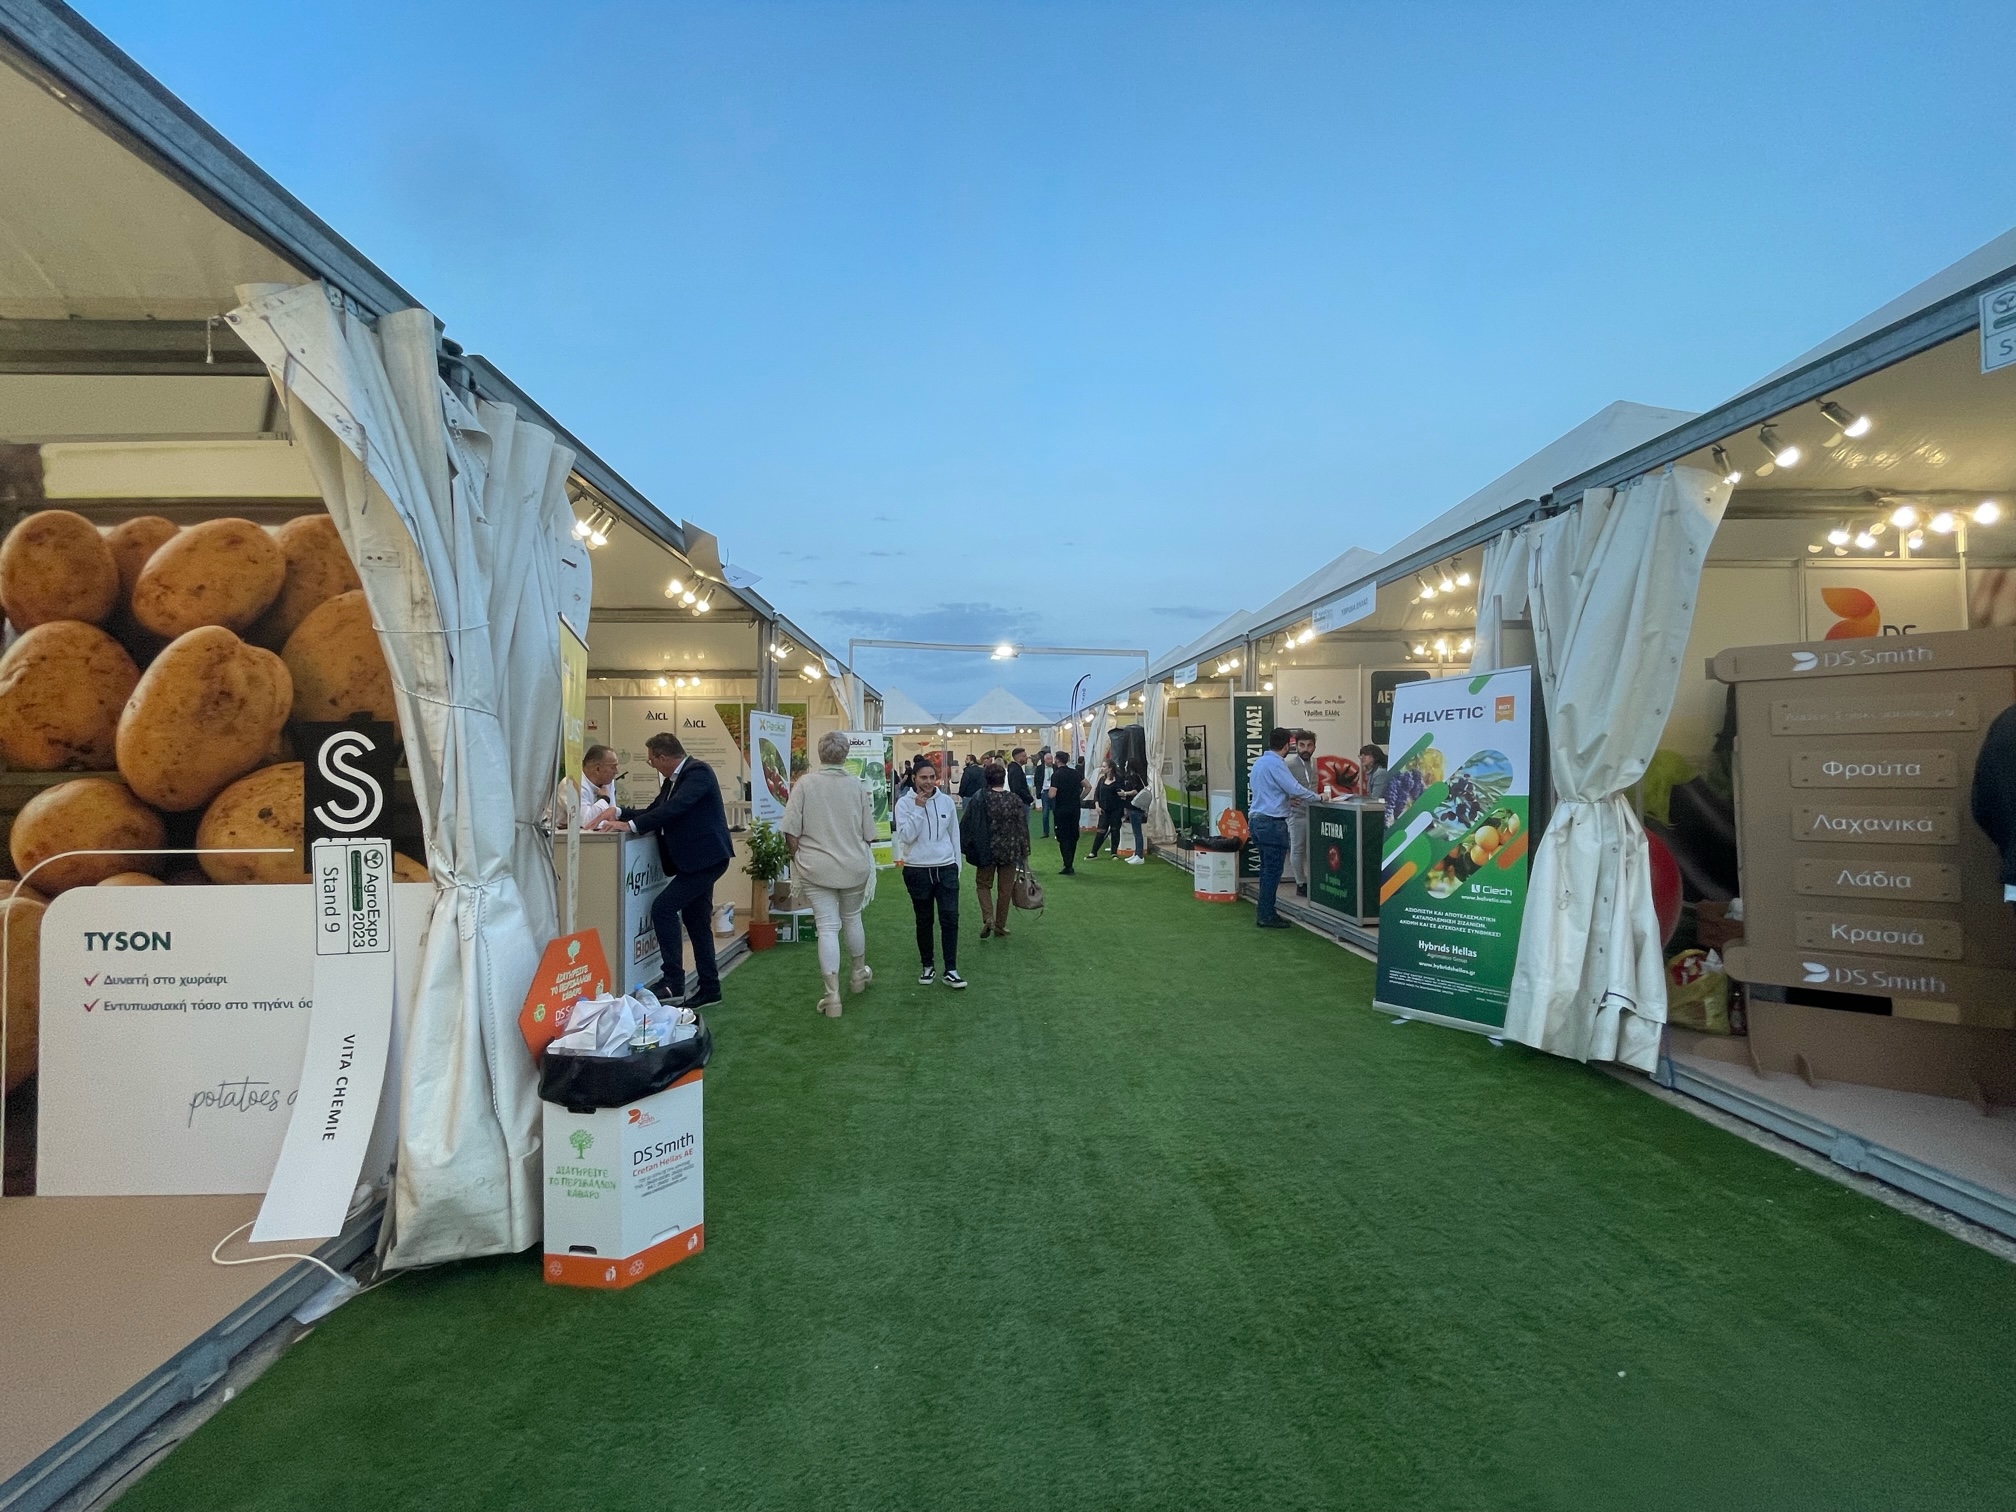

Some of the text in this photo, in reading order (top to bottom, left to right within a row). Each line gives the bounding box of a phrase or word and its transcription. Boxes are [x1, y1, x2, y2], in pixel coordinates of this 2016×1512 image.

[1824, 647, 1933, 667] DS Smith
[1403, 706, 1484, 724] HALVETIC
[1246, 743, 1263, 777] ΑΖΙ
[1822, 760, 1921, 779] Φρούτα
[1321, 821, 1344, 840] AETHRA
[1813, 815, 1933, 834] Λαχανικά
[1837, 870, 1912, 888] Λάδια
[323, 867, 341, 934] Stand 9
[1482, 885, 1513, 897] Ciech
[364, 873, 381, 947] AgroExpo
[352, 913, 366, 948] 2023
[1831, 924, 1924, 945] Κρασιά
[84, 931, 172, 951] TYSON
[1418, 940, 1477, 958] Hybrids Hellas
[104, 973, 228, 987] Δυνατή στο χωράφι
[1834, 968, 1946, 993] DS Smith
[104, 999, 188, 1012] Εντυπωσιακή
[191, 1000, 221, 1011] τόσο
[225, 1001, 249, 1010] στο
[252, 998, 294, 1012] τηγάνι
[322, 1034, 356, 1141] VITA CHEMIE
[188, 1076, 280, 1128] potatoes
[633, 1132, 694, 1166] DS Smith
[633, 1163, 659, 1177] Cretan
[659, 1153, 683, 1167] Hellas
